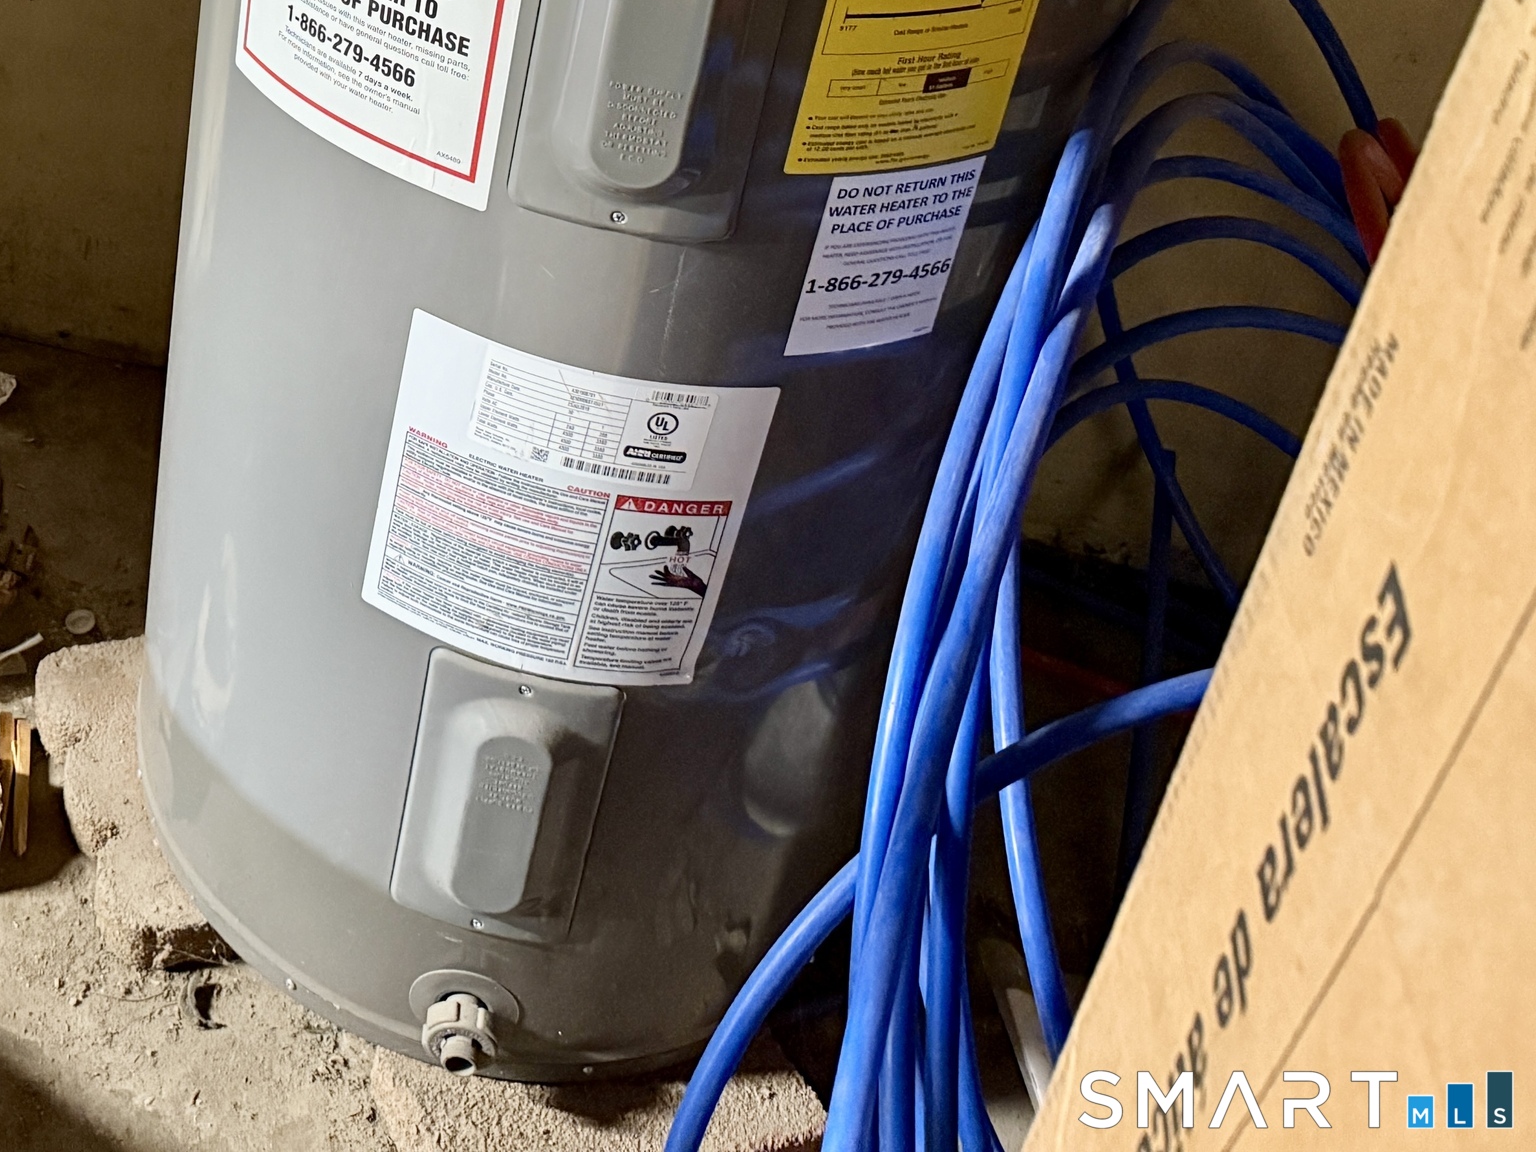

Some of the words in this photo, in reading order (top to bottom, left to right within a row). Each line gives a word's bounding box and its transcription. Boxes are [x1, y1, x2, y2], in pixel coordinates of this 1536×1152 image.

[338, 8, 352, 19] with
[353, 15, 365, 26] this
[367, 23, 387, 36] water
[388, 32, 414, 49] heater,
[416, 45, 445, 63] missing
[447, 58, 470, 72] parts,
[367, 0, 471, 58] PURCHASE
[287, 4, 416, 88] 1-866-279-4566
[338, 18, 355, 32] have
[355, 29, 382, 44] general
[384, 40, 419, 61] questions
[421, 57, 435, 68] call
[437, 62, 449, 73] toll
[450, 68, 469, 81] free:
[897, 55, 915, 65] First
[917, 53, 937, 63] Hour
[938, 51, 962, 61] Rating
[285, 25, 316, 52] Technicians
[329, 54, 357, 76] available
[364, 74, 382, 89] days
[390, 86, 413, 102] week.
[288, 39, 301, 53] more
[338, 71, 351, 82] see
[352, 77, 363, 88] the
[364, 84, 391, 103] owner's
[392, 97, 420, 115] manual
[293, 53, 318, 73] provided
[319, 69, 331, 81] with
[332, 78, 348, 92] your
[348, 85, 367, 101] water
[368, 95, 394, 114] heater.
[609, 81, 644, 94] POWER
[647, 87, 683, 100] SUPPLY
[607, 101, 678, 120] DISCONNECTED
[622, 93, 650, 104] MUST
[613, 122, 664, 138] ADJUSTING
[621, 113, 658, 126] BEFORE
[604, 130, 669, 148] THERMOSTAT
[619, 153, 644, 163] ECO
[837, 188, 859, 199] DO
[863, 185, 893, 197] NOT
[895, 177, 947, 194] RETURN
[950, 169, 976, 184] THIS
[829, 204, 877, 217] WATER
[879, 197, 928, 213] HEATER
[932, 192, 949, 204] TO
[951, 186, 974, 200] THE
[830, 222, 872, 234] PLACE
[876, 219, 895, 230] OF
[897, 205, 963, 228] PURCHASE
[805, 258, 952, 294] 1-866-279-4566
[1364, 332, 1400, 419] MADE
[408, 426, 448, 448] WARNING
[468, 454, 497, 470] ELECTRIC
[498, 464, 518, 476] WATER
[519, 471, 544, 483] HEATER
[651, 452, 685, 461] CERTIFIED
[567, 485, 611, 498] CAUTION
[644, 501, 724, 516] DANGER
[1303, 456, 1351, 557] MEXICO
[668, 555, 691, 564] HOT
[1255, 561, 1414, 924] Escalera
[1213, 908, 1254, 1030] de
